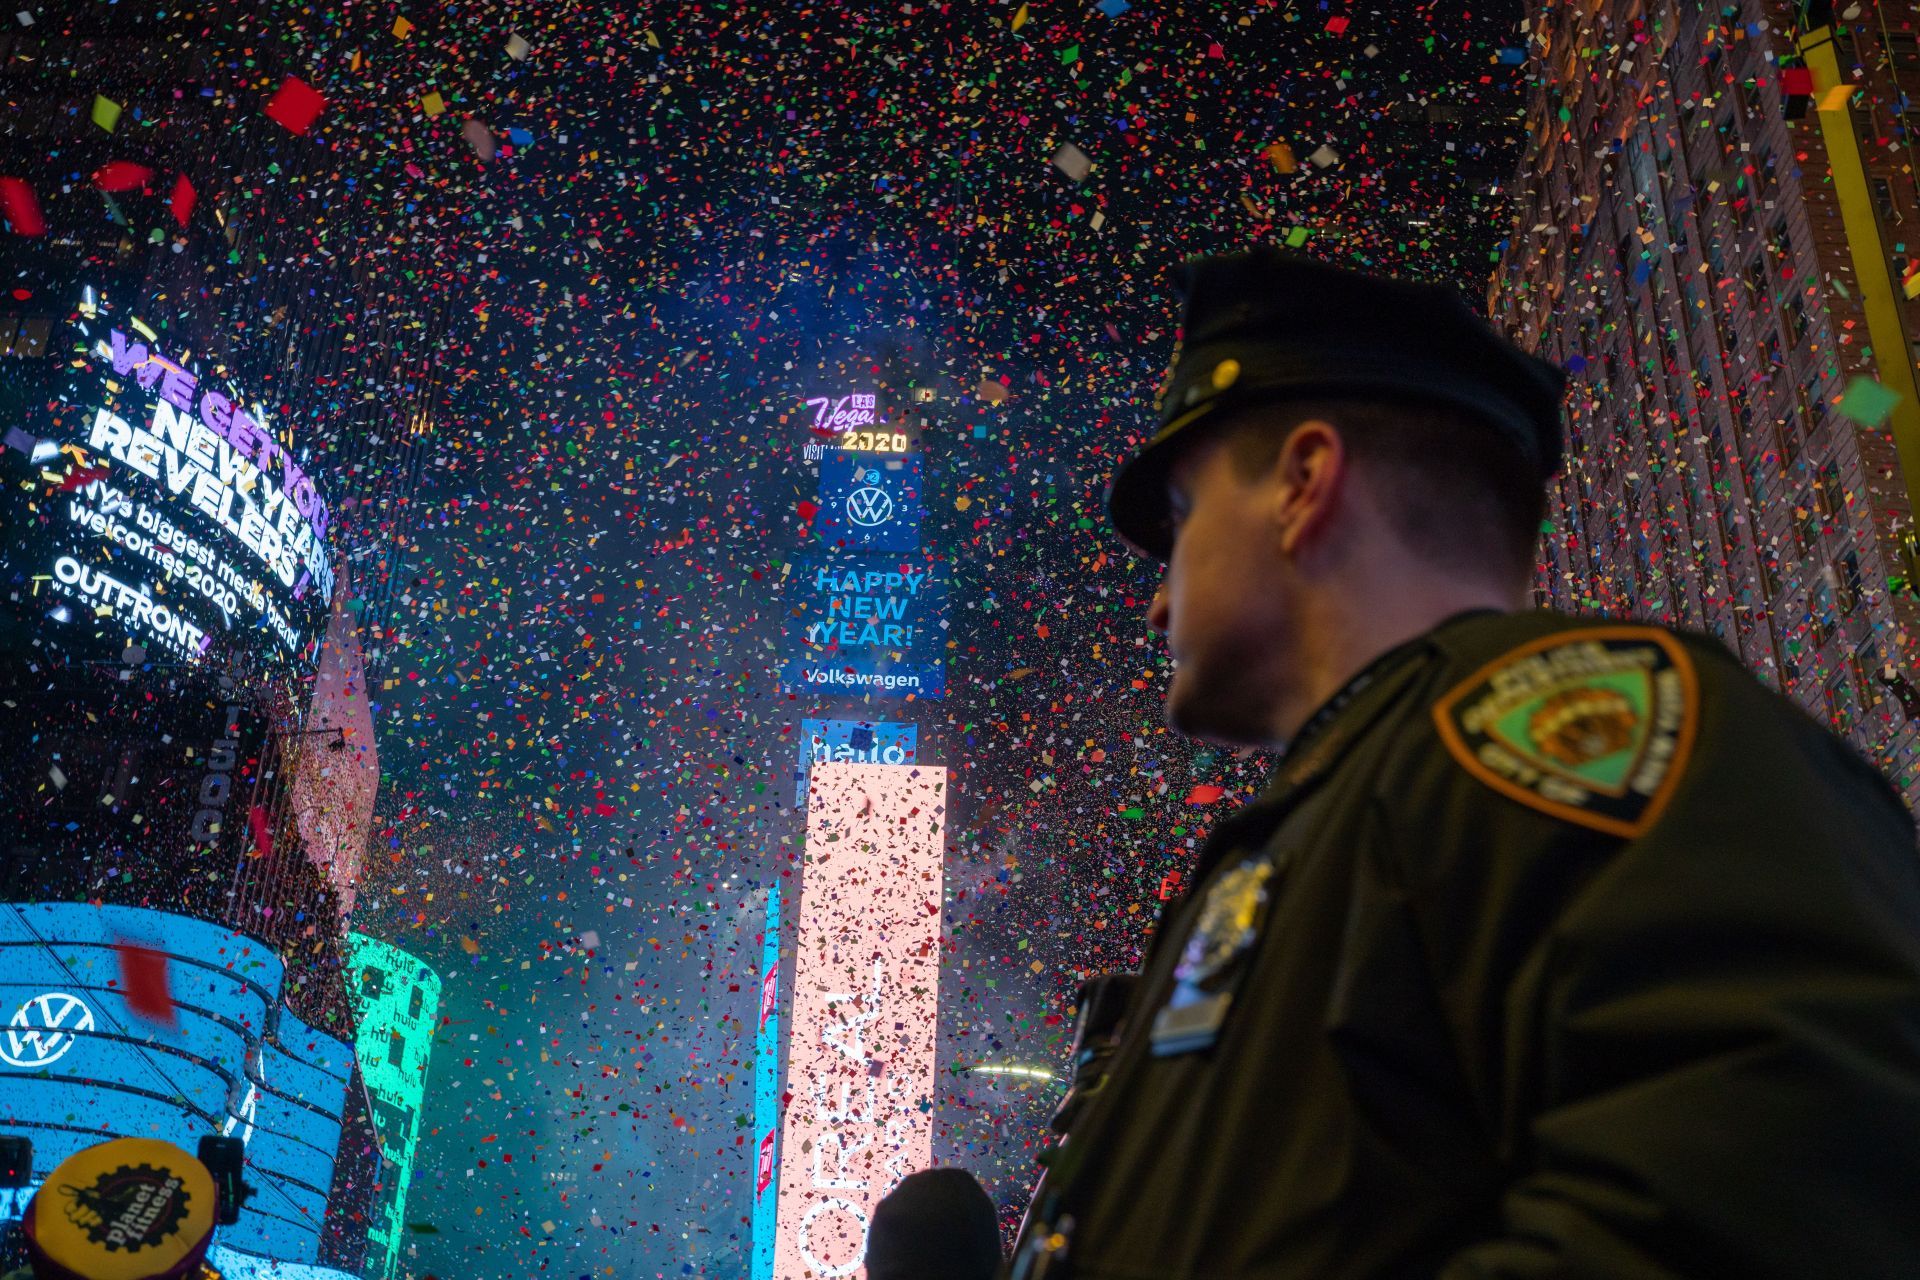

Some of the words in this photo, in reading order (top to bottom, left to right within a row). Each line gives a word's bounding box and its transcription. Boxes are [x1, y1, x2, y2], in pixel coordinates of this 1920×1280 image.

[807, 396, 887, 433] Vega
[851, 394, 875, 409] LAS
[111, 328, 198, 413] WE
[201, 392, 279, 473] GET
[283, 451, 329, 540] YOU
[151, 397, 260, 497] NEW
[843, 431, 907, 453] 2020
[89, 407, 295, 588] REVELERS
[137, 503, 216, 570] biggest
[54, 556, 204, 654] OUTFRONT
[184, 564, 237, 615] 2020
[816, 570, 925, 595] HAPPY
[829, 596, 908, 620] NEW
[817, 621, 913, 647] YEAR!
[806, 669, 920, 690] Volkswagen
[107, 1183, 155, 1245] planet
[126, 1179, 179, 1241] fitness
